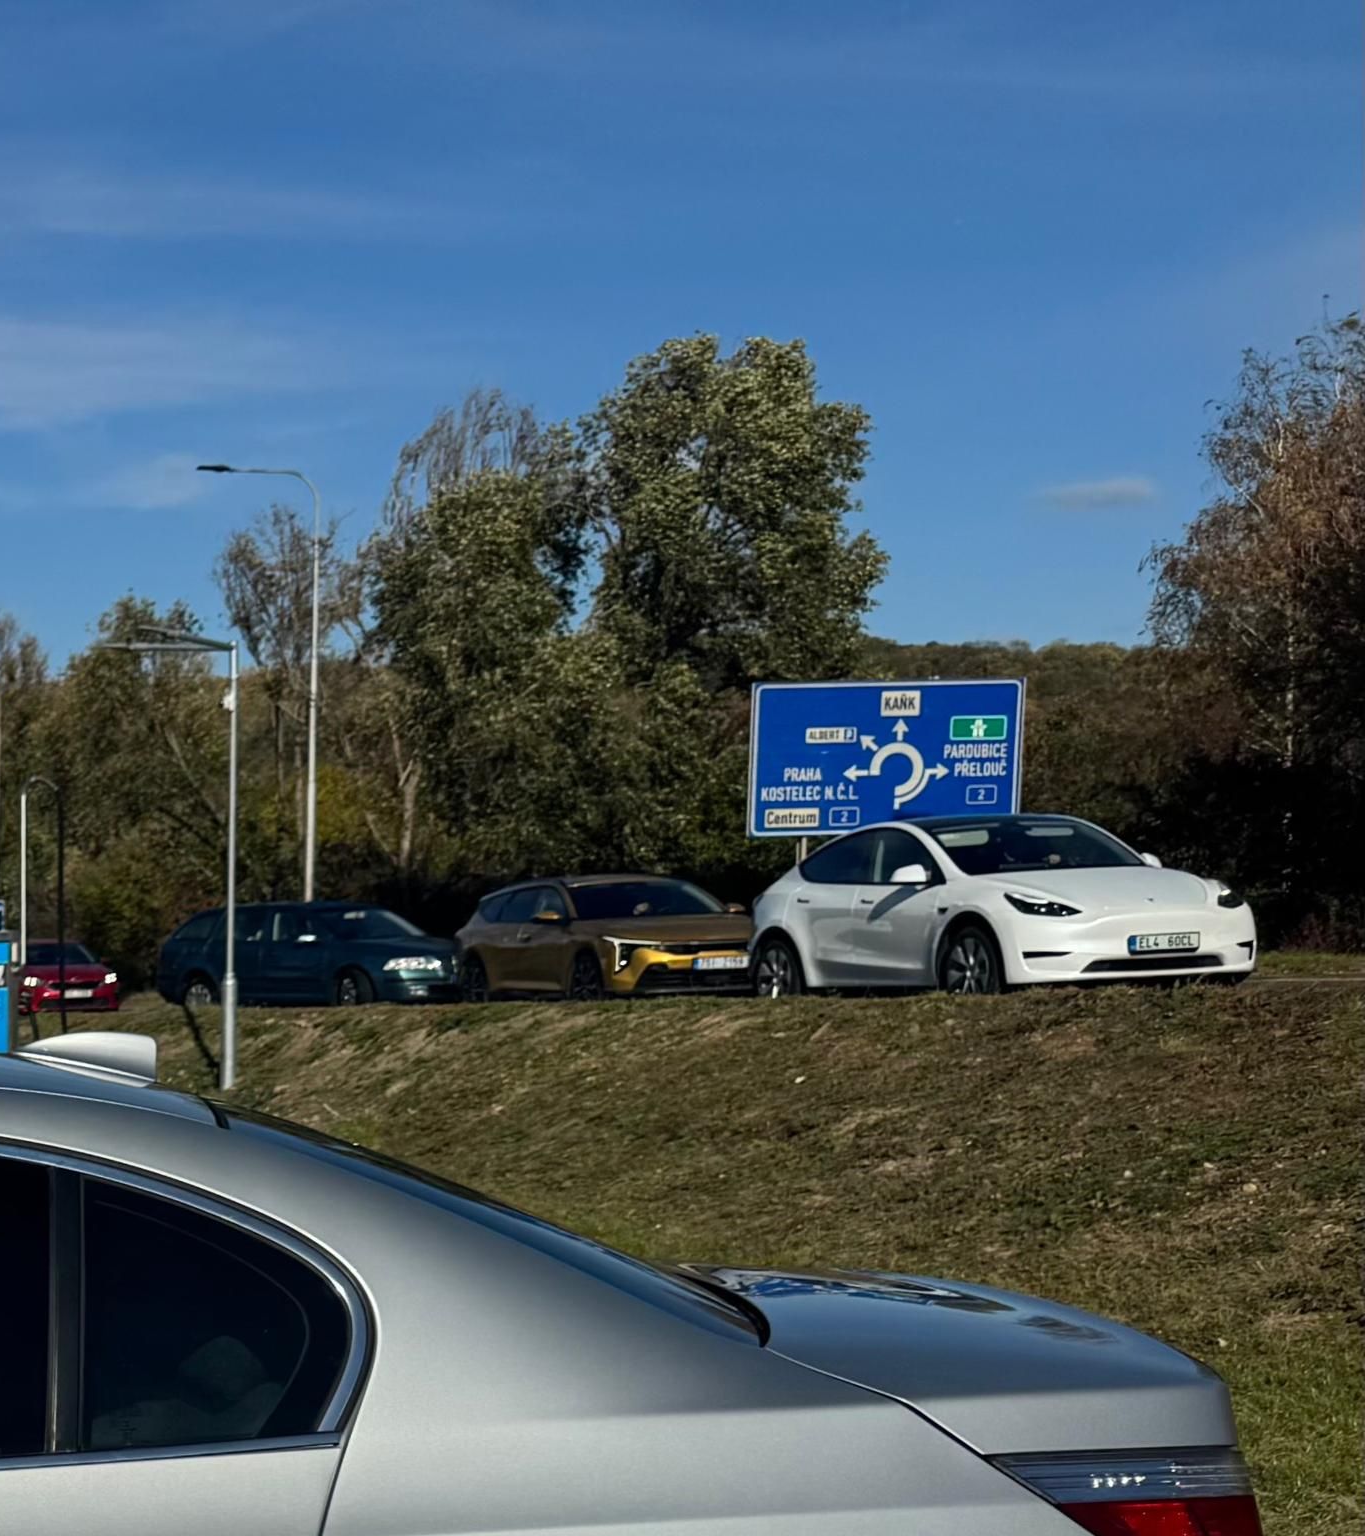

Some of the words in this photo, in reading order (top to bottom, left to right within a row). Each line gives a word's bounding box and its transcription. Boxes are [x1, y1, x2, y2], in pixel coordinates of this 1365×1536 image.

[884, 693, 916, 711] KAŇK
[943, 743, 1008, 759] PARDUBICE
[783, 767, 822, 782] PRAHA
[953, 759, 1007, 777] PŘELOUČ
[760, 785, 821, 802] KOSTELEC
[977, 789, 985, 801] 2
[766, 811, 817, 825] Centrum
[840, 811, 848, 823] 2
